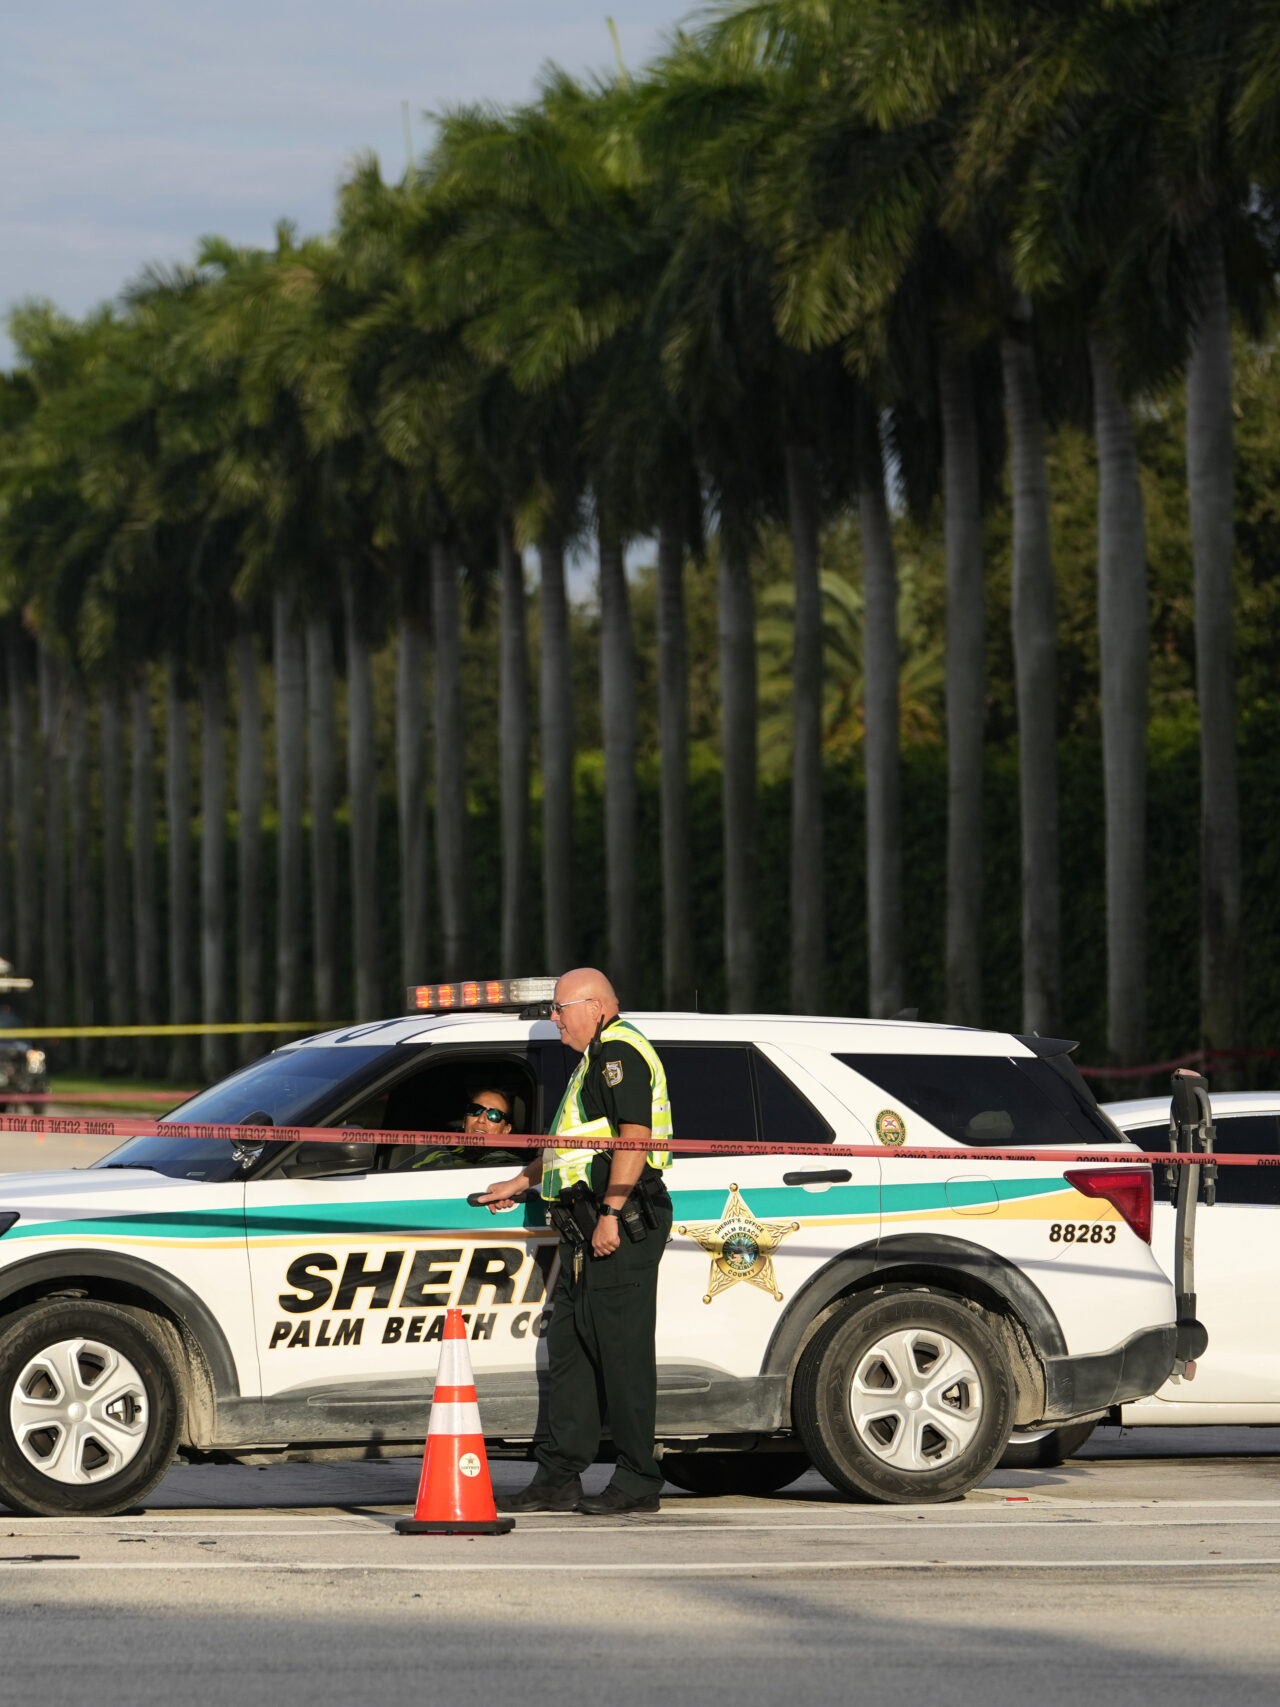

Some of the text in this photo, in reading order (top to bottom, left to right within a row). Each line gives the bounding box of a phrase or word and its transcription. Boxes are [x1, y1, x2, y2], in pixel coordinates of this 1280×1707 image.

[714, 1218, 764, 1234] SHERIFF'S OFFICE
[721, 1226, 759, 1240] PALM BEACH
[1049, 1223, 1117, 1244] 88283
[278, 1244, 559, 1314] SHERI
[728, 1269, 755, 1277] COUNTY
[269, 1317, 365, 1349] PALM
[381, 1312, 497, 1344] BEAH
